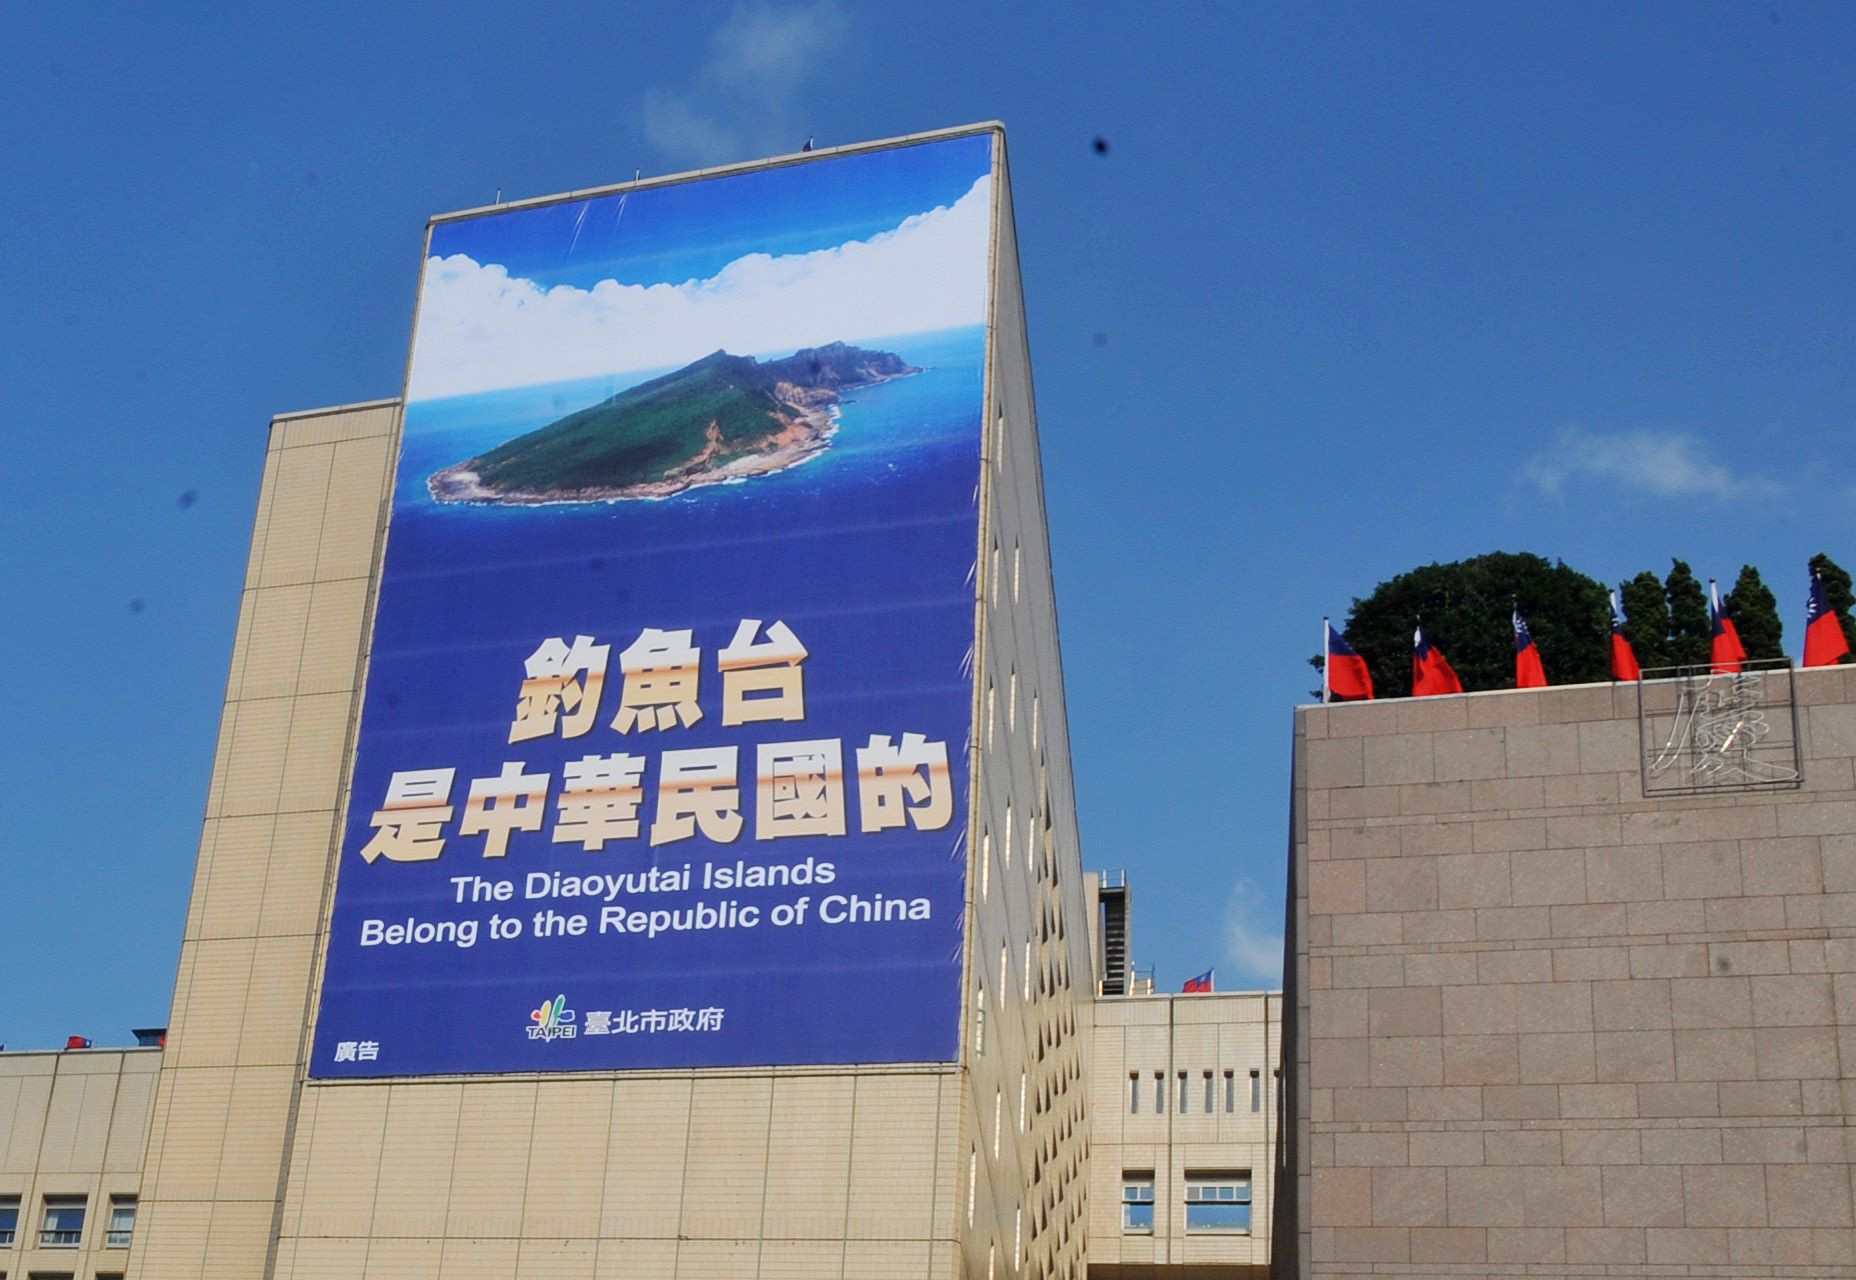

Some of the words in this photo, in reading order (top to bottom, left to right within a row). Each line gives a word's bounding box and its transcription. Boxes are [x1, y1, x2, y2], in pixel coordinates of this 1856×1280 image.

[508, 618, 809, 744] 釣魚台
[361, 732, 953, 864] 是中華民國的
[450, 876, 514, 903] The
[525, 863, 691, 901] Diaoyutai
[703, 857, 836, 889] Islands
[360, 918, 478, 948] Belong
[489, 914, 522, 939] to
[533, 910, 588, 937] the
[599, 901, 760, 938] Republic
[771, 897, 810, 926] of
[819, 893, 931, 924] China
[526, 1025, 577, 1040] TAIPEI
[584, 1007, 724, 1036] 臺北市政府
[334, 1041, 379, 1063] 廣告
